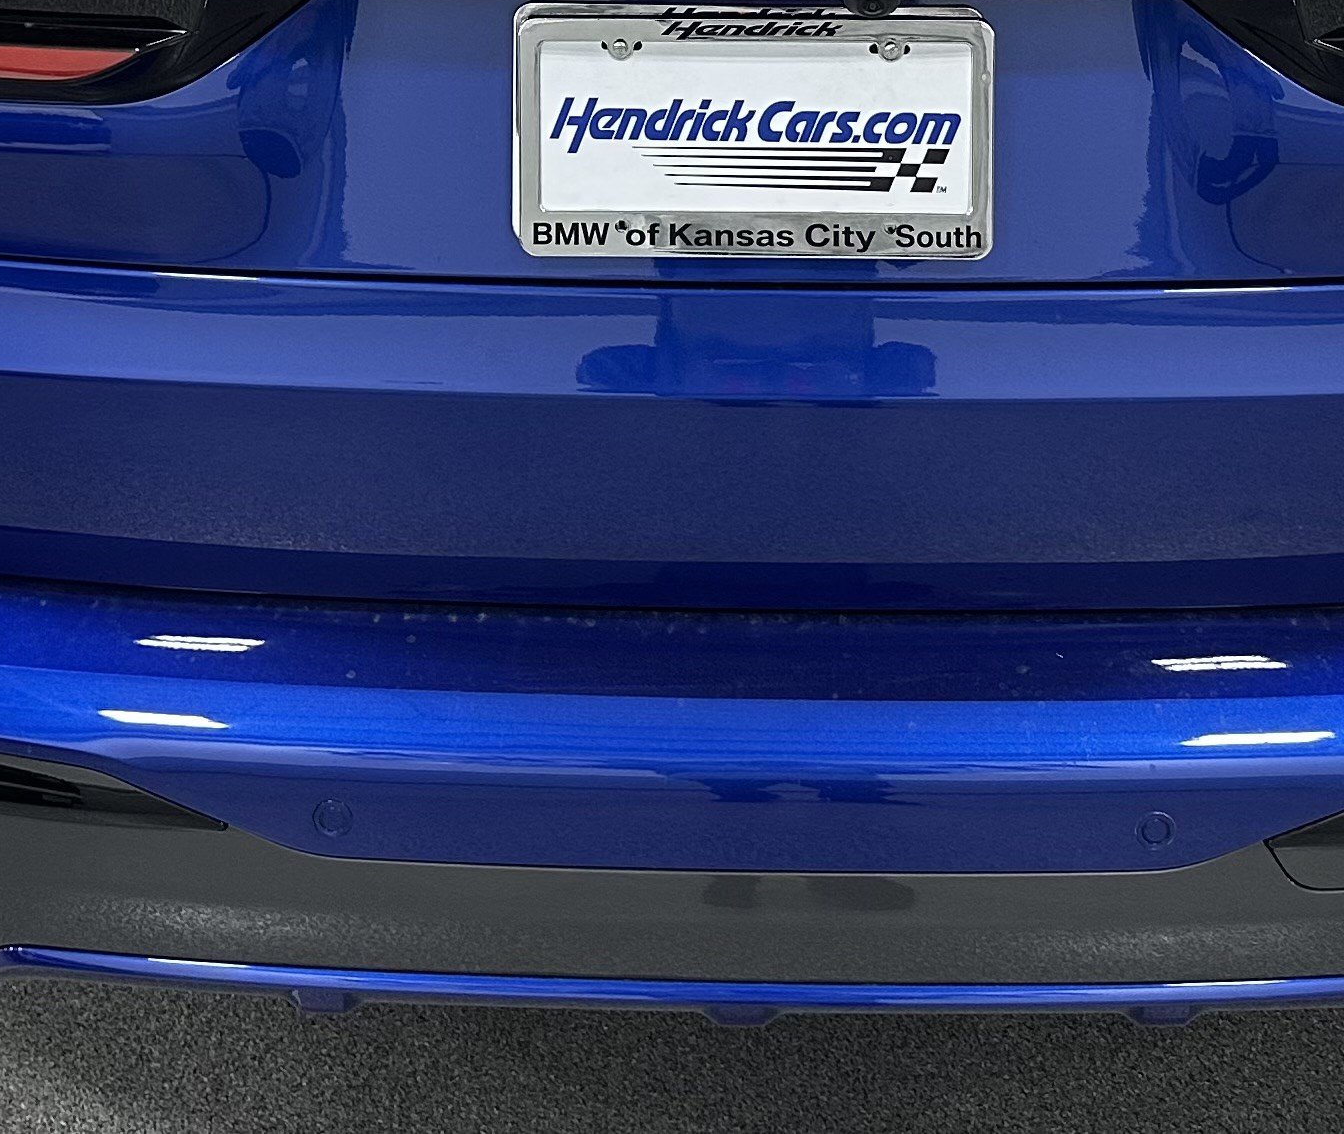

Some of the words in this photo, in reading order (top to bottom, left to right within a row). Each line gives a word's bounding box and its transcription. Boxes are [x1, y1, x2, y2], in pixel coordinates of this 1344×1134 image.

[660, 20, 844, 41] Hendrick
[532, 222, 610, 246] BMW
[625, 223, 661, 247] of
[668, 223, 795, 248] Kansas
[805, 223, 876, 253] City
[895, 224, 983, 249] South
